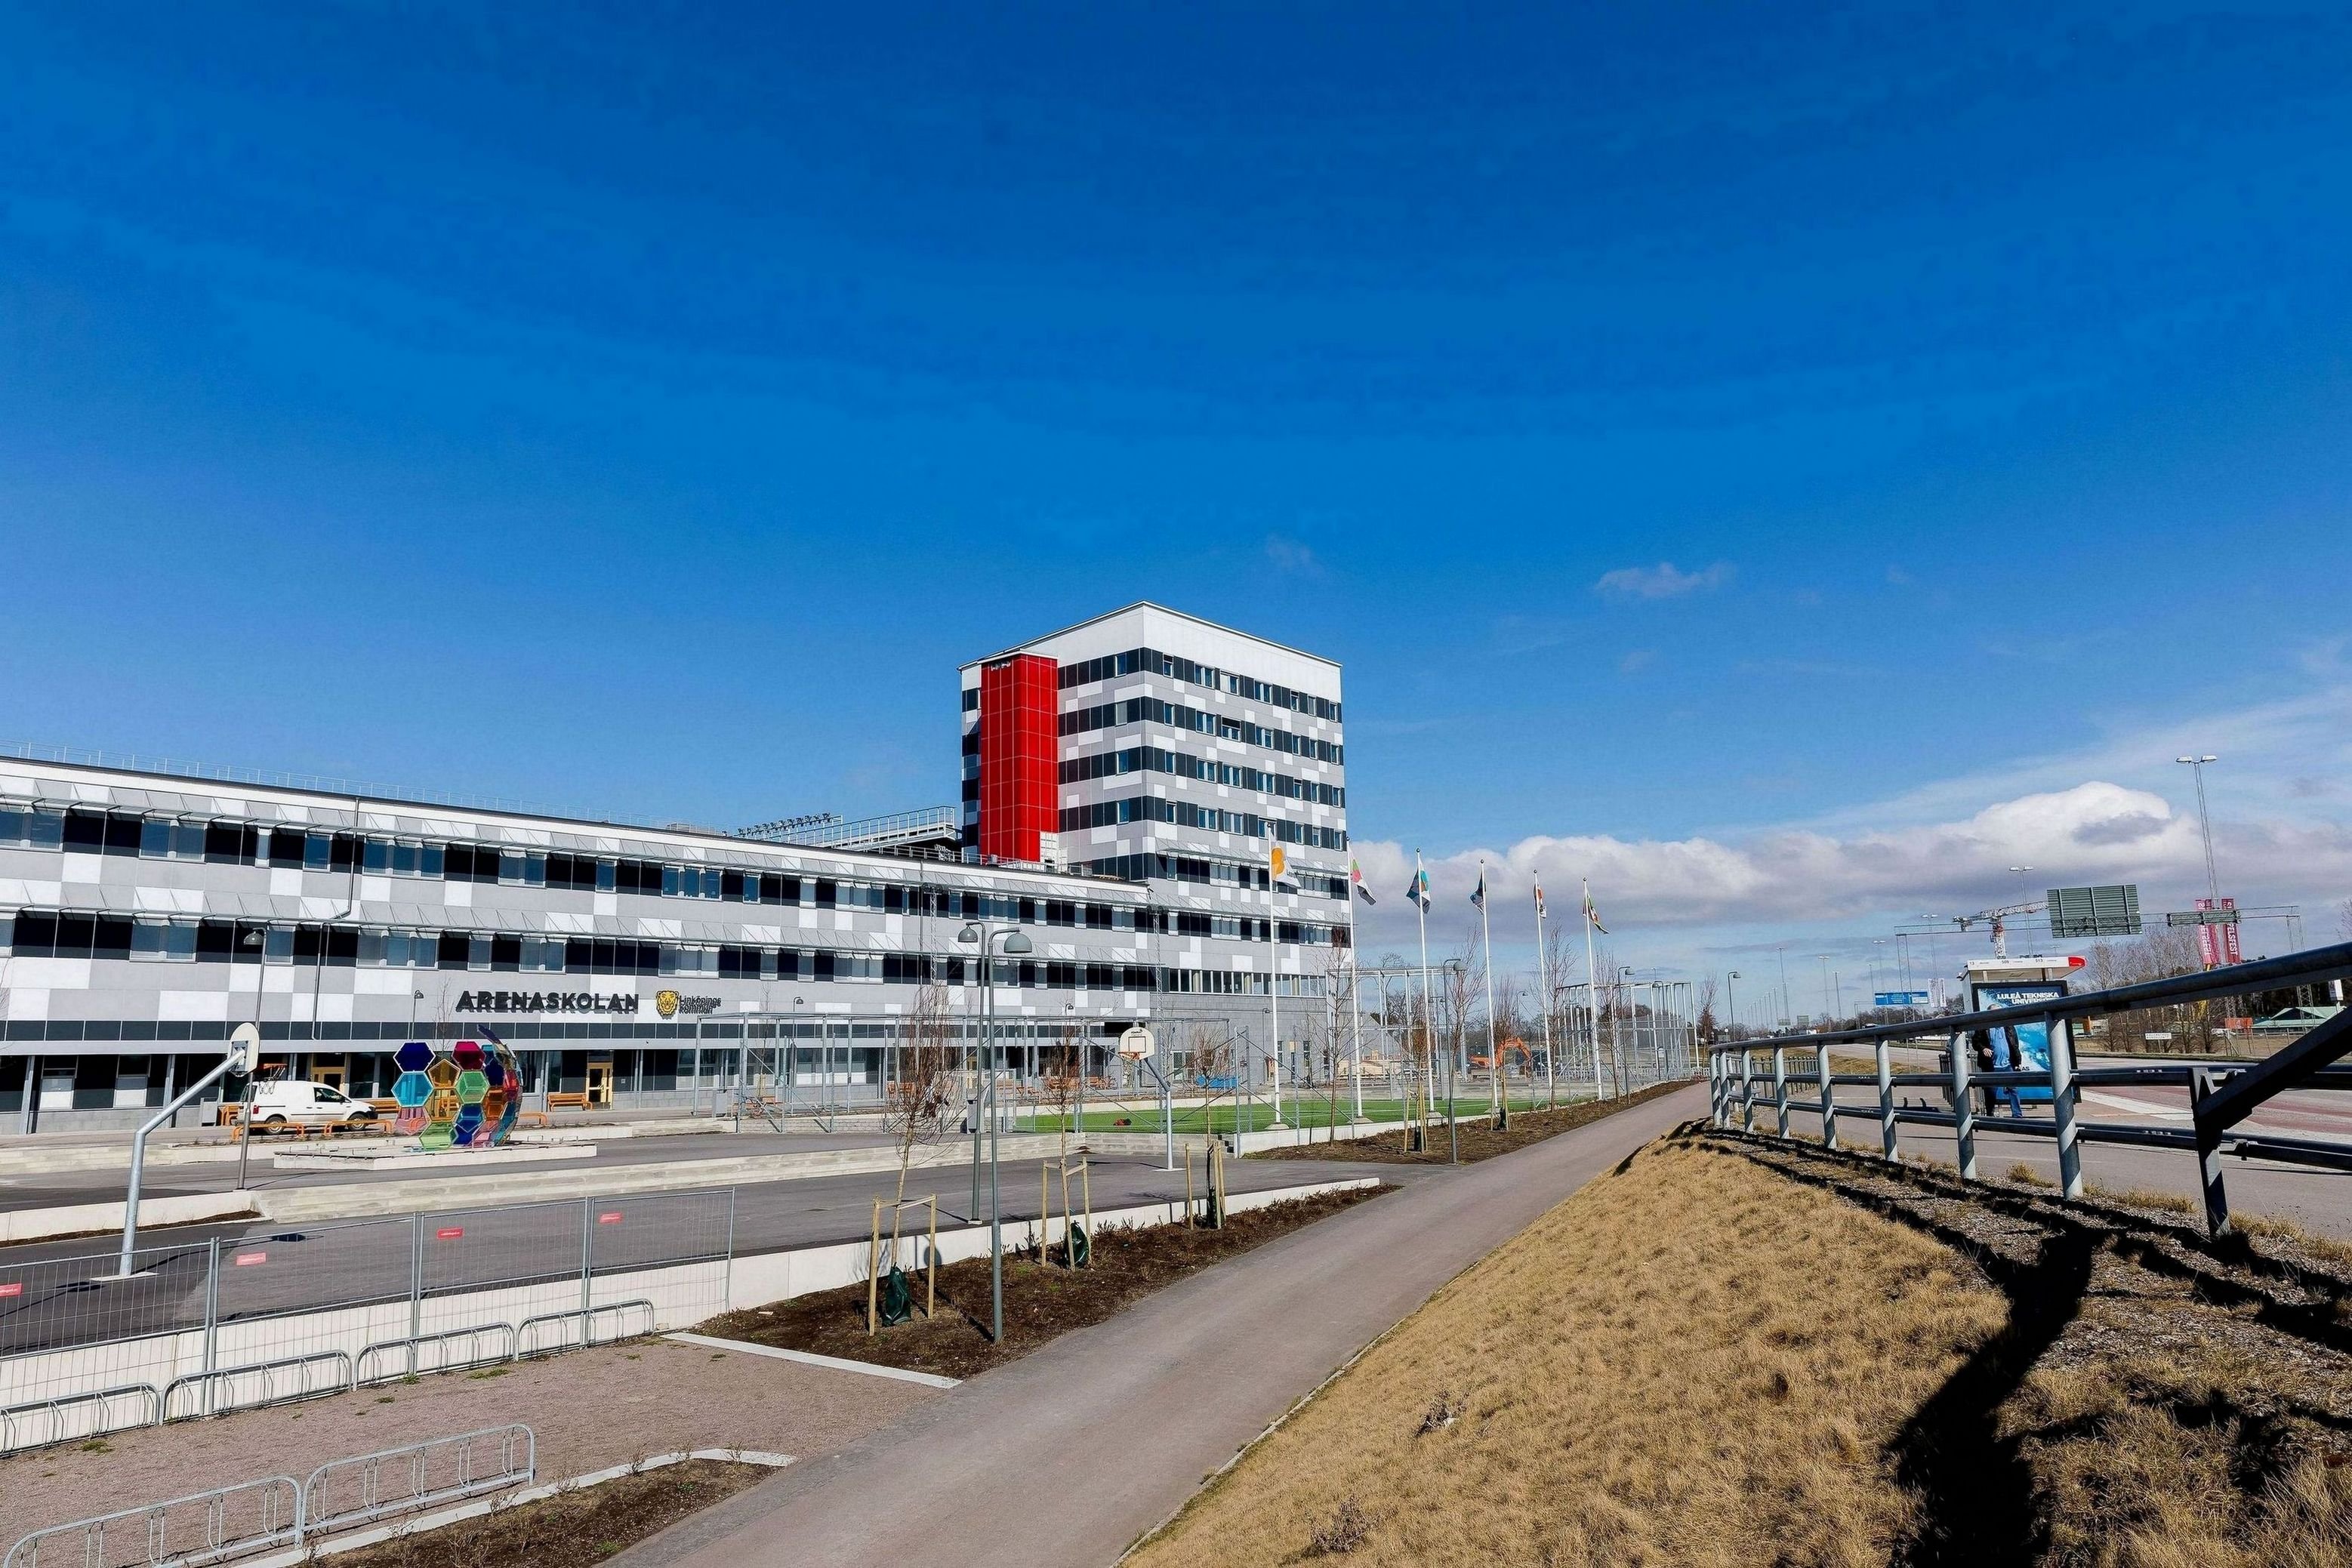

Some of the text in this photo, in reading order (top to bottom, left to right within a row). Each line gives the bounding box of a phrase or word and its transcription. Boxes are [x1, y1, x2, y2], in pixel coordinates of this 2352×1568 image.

[455, 990, 640, 1013] ARENASKOLAN
[680, 995, 722, 1008] Linköpings
[1997, 991, 2059, 1000] LULEÅ TEKNISKA
